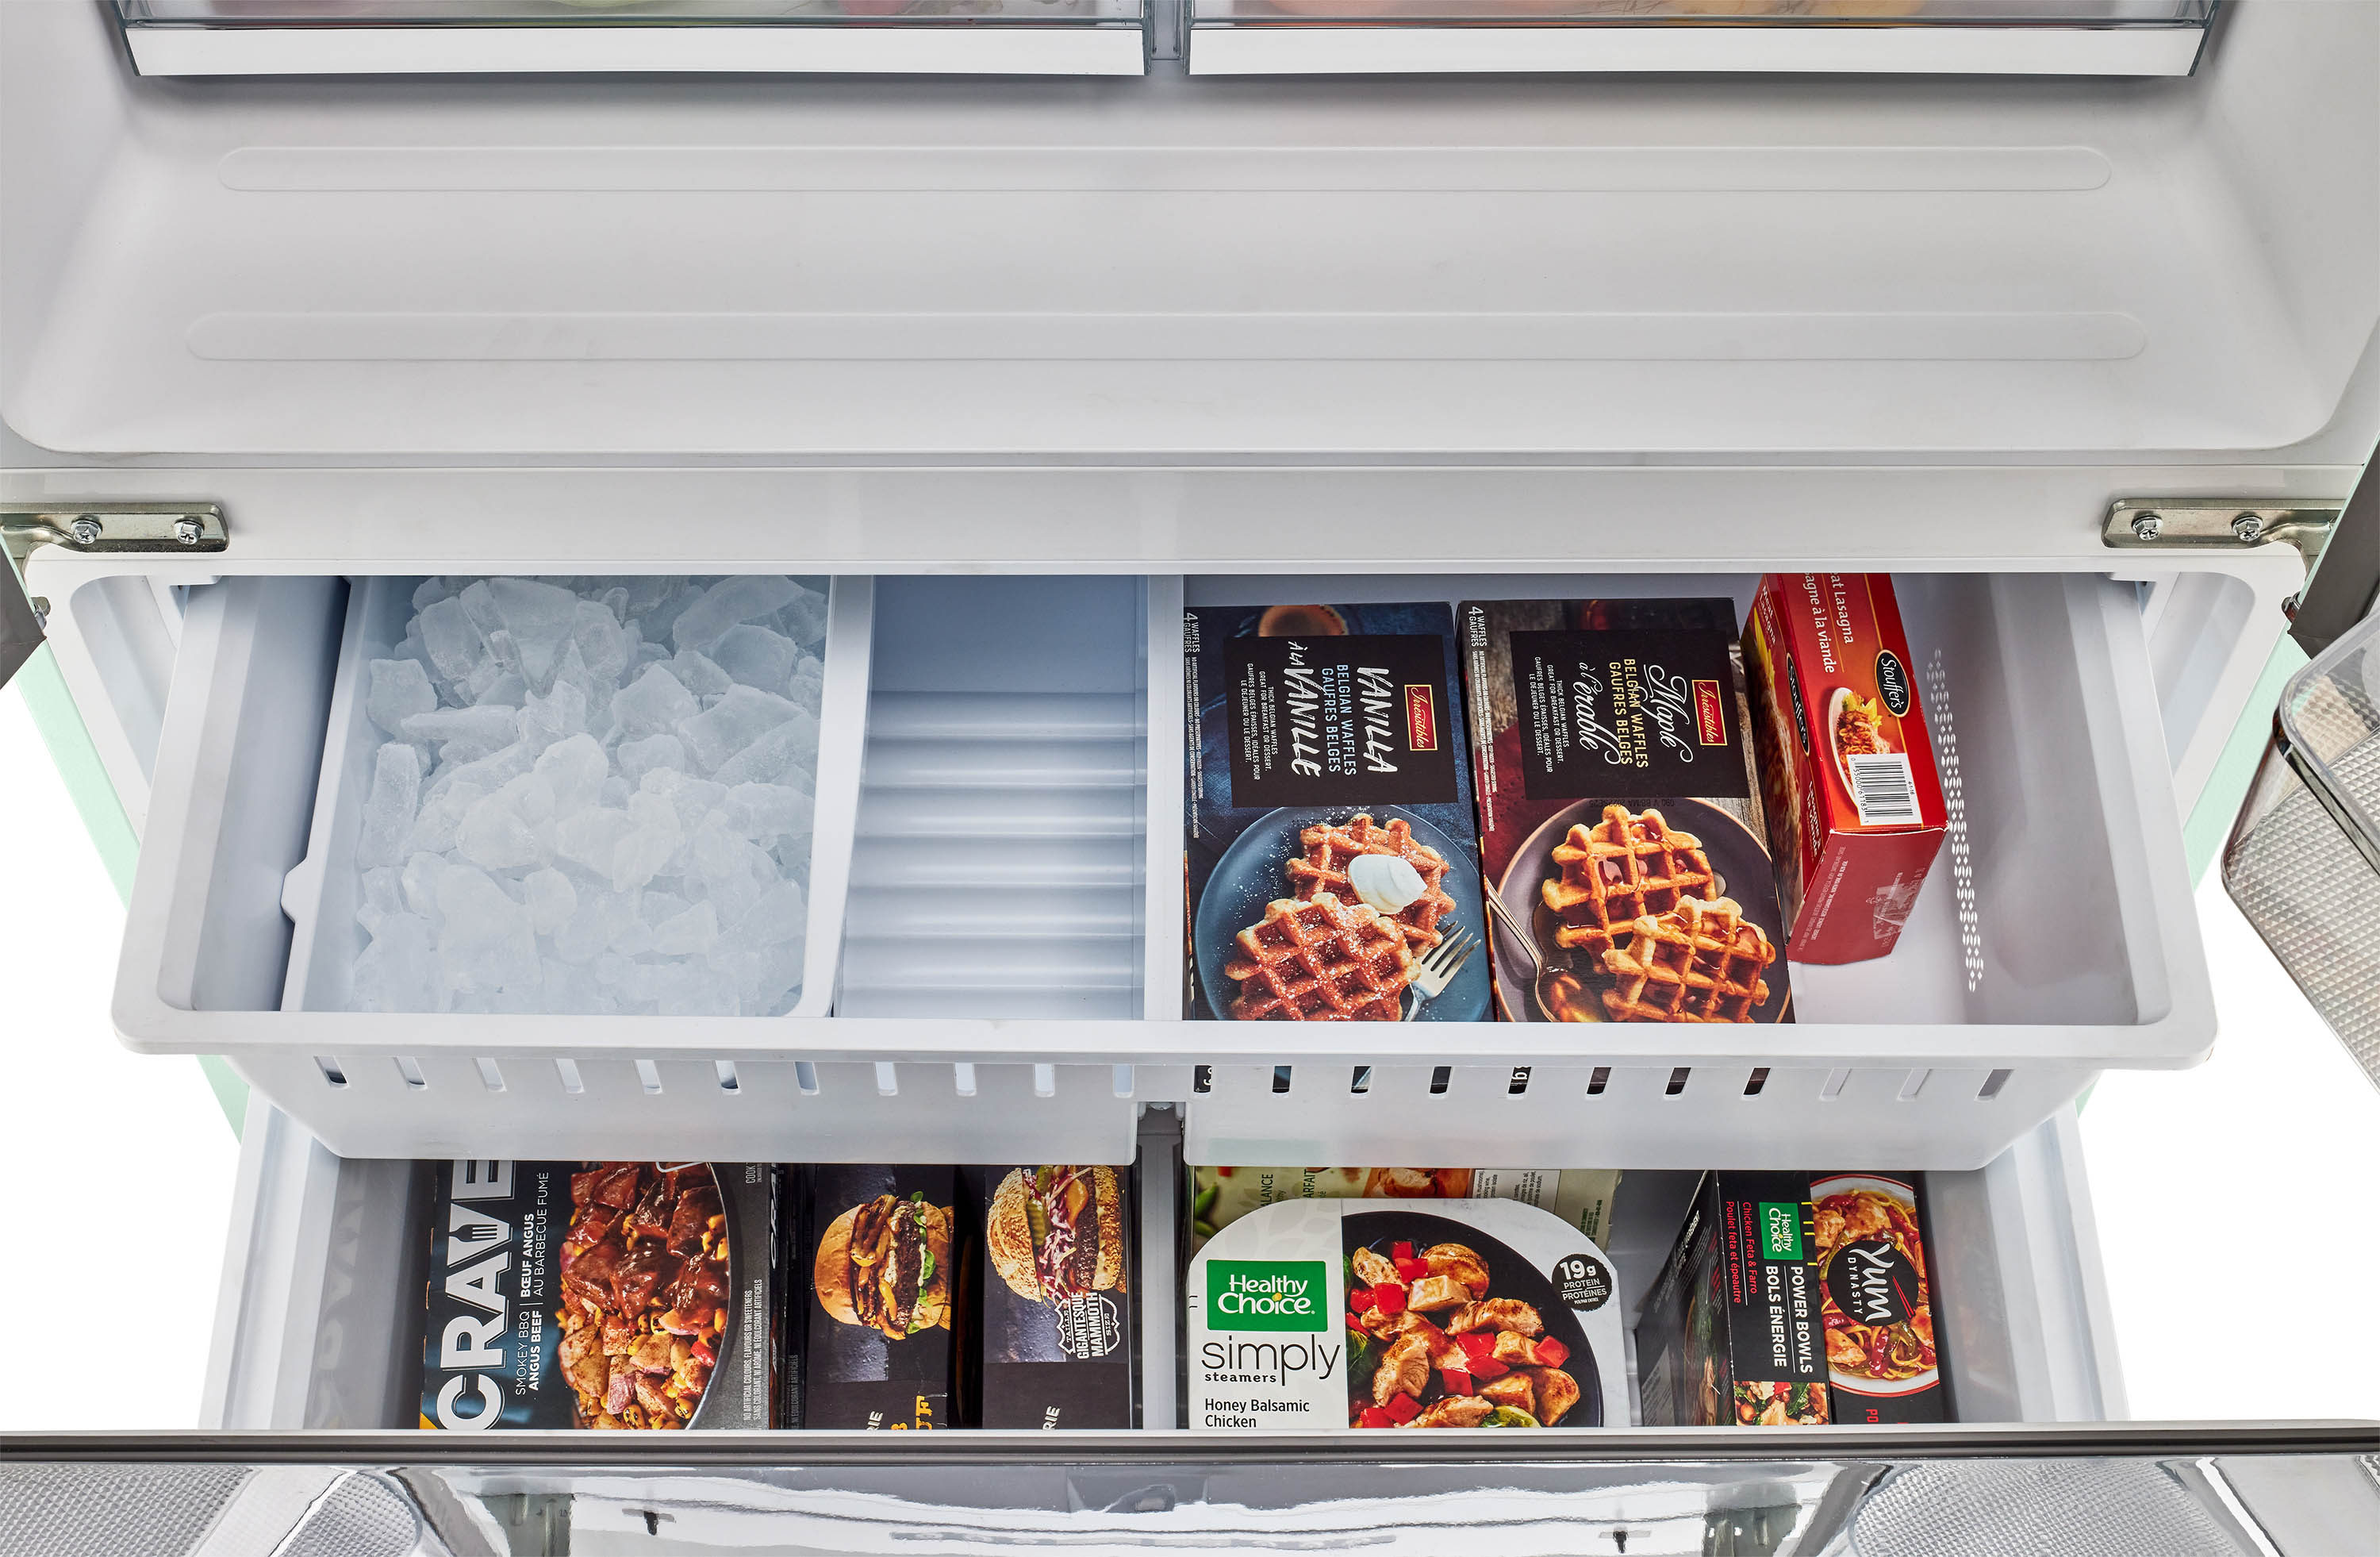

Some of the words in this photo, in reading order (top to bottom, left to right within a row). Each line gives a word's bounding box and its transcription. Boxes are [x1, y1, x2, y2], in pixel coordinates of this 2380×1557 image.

[1183, 613, 1198, 621] 4
[1468, 606, 1484, 615] 4
[1815, 618, 1826, 628] la
[1834, 592, 1853, 643] Lasagna
[1191, 622, 1200, 652] WAFFLES
[1288, 641, 1307, 651] À
[1468, 616, 1479, 647] GAUFRES
[1477, 616, 1487, 647] WAFFLES
[1289, 652, 1304, 665] LA
[1579, 662, 1595, 671] à
[1818, 631, 1836, 673] viande
[1322, 668, 1337, 721] GAUFRES
[1337, 665, 1352, 713] BELGIAN
[1609, 662, 1626, 715] GAUFRES
[1624, 659, 1641, 707] BELGIAN
[1881, 659, 1904, 708] Stouffer's
[1284, 668, 1324, 777] VANILLE
[1357, 667, 1398, 773] VANILLA
[1411, 687, 1429, 748] Irresistibles
[1639, 664, 1694, 762] Maple
[1699, 682, 1718, 742] Irresistibles
[1788, 666, 1808, 744] Stouffer's
[1251, 740, 1260, 762] IDÉALES
[1326, 726, 1341, 771] BELGES
[1341, 720, 1357, 775] WAFFLES
[1535, 729, 1544, 755] DESSERT.
[1543, 732, 1552, 755] IDÉALES
[1560, 722, 1569, 747] WAFFLES
[1616, 720, 1633, 764] BELGES
[1631, 713, 1649, 767] WAFFLES
[536, 1173, 549, 1205] FUMÉ
[746, 1166, 755, 1183] COOK
[1726, 1201, 1736, 1229] Poulet
[1742, 1201, 1753, 1236] Chicken
[1768, 1207, 1783, 1252] Choice
[1782, 1213, 1794, 1251] Healthy
[522, 1213, 534, 1257] ANGUS
[534, 1209, 547, 1275] BARBECUE
[1729, 1232, 1737, 1248] feta
[1746, 1239, 1755, 1258] Feta
[1730, 1251, 1738, 1260] et
[436, 1160, 515, 1429] CRAVE
[520, 1261, 532, 1297] BŒUF
[533, 1279, 543, 1296] AU
[1229, 1274, 1308, 1297] Healthy
[1563, 1288, 1606, 1300] PROTÉINES
[1564, 1278, 1600, 1289] PROTEIN
[1729, 1263, 1741, 1303] épeautre
[1749, 1270, 1758, 1294] Farro
[1766, 1266, 1780, 1301] BOLS
[1791, 1267, 1807, 1317] POWER
[1848, 1244, 1894, 1321] Yum
[1848, 1257, 1863, 1313] DYNASTY
[744, 1290, 753, 1323] SWEETENERS
[1218, 1292, 1311, 1314] Choice
[517, 1311, 530, 1338] BBQ
[530, 1311, 542, 1342] BEEF
[1071, 1291, 1089, 1359] GIGANTESQUE
[1085, 1292, 1104, 1356] MAMMOTH
[1769, 1306, 1787, 1367] ÉNERGIE
[1201, 1333, 1341, 1386] simply
[1796, 1321, 1813, 1373] BOWLS
[516, 1343, 528, 1396] SMOKEY
[528, 1346, 540, 1390] ANGUS
[1204, 1372, 1276, 1382] steamers
[743, 1385, 752, 1411] ARTIFICIAL
[1205, 1398, 1246, 1413] Honey
[1250, 1399, 1310, 1412] Balsamic
[1205, 1415, 1257, 1428] Chicken
